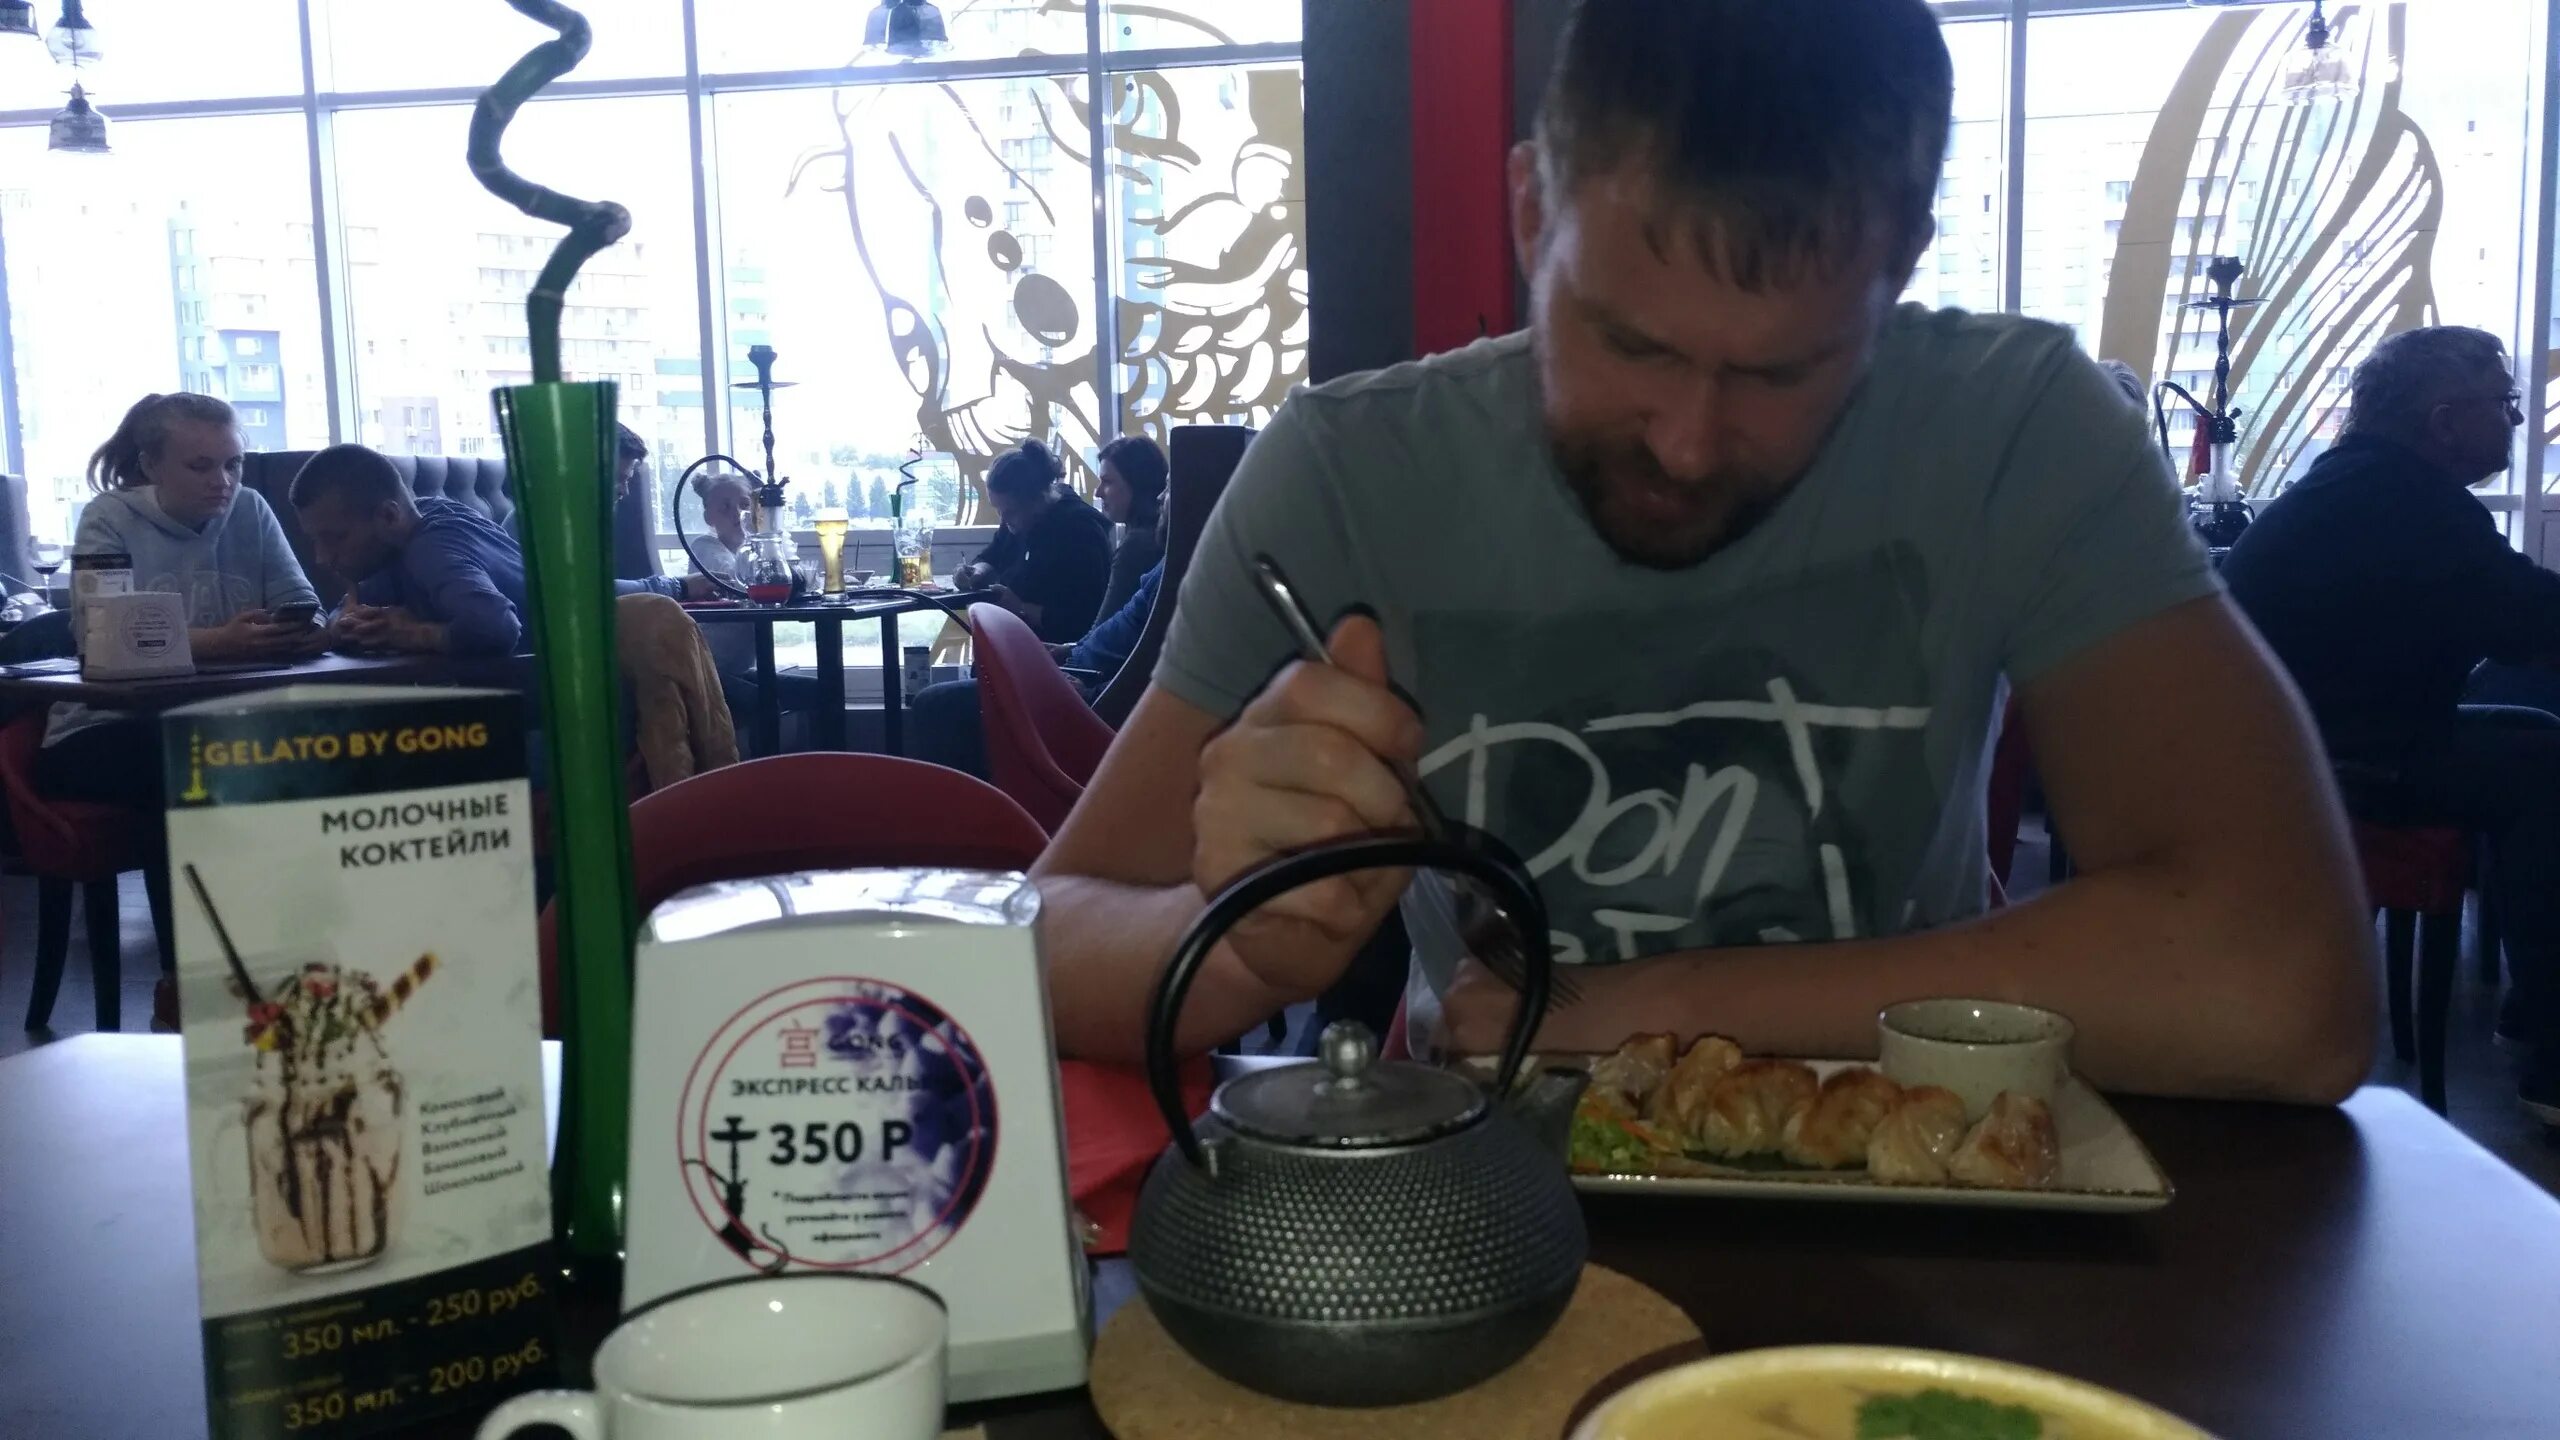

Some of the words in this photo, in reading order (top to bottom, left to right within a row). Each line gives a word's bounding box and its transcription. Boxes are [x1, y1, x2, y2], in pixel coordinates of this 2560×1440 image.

[203, 735, 341, 767] GELATO
[349, 729, 388, 758] BY
[396, 722, 488, 753] GONG
[321, 794, 510, 834] МОЛОЧНЫЕ
[340, 828, 511, 869] КОКТЕЙЛИ
[731, 1075, 851, 1098] ЭКСПРЕСС
[768, 1121, 864, 1167] 350
[281, 1322, 345, 1360] 350
[427, 1288, 482, 1327] 250
[284, 1392, 346, 1430] 350
[428, 1357, 486, 1395] 200
